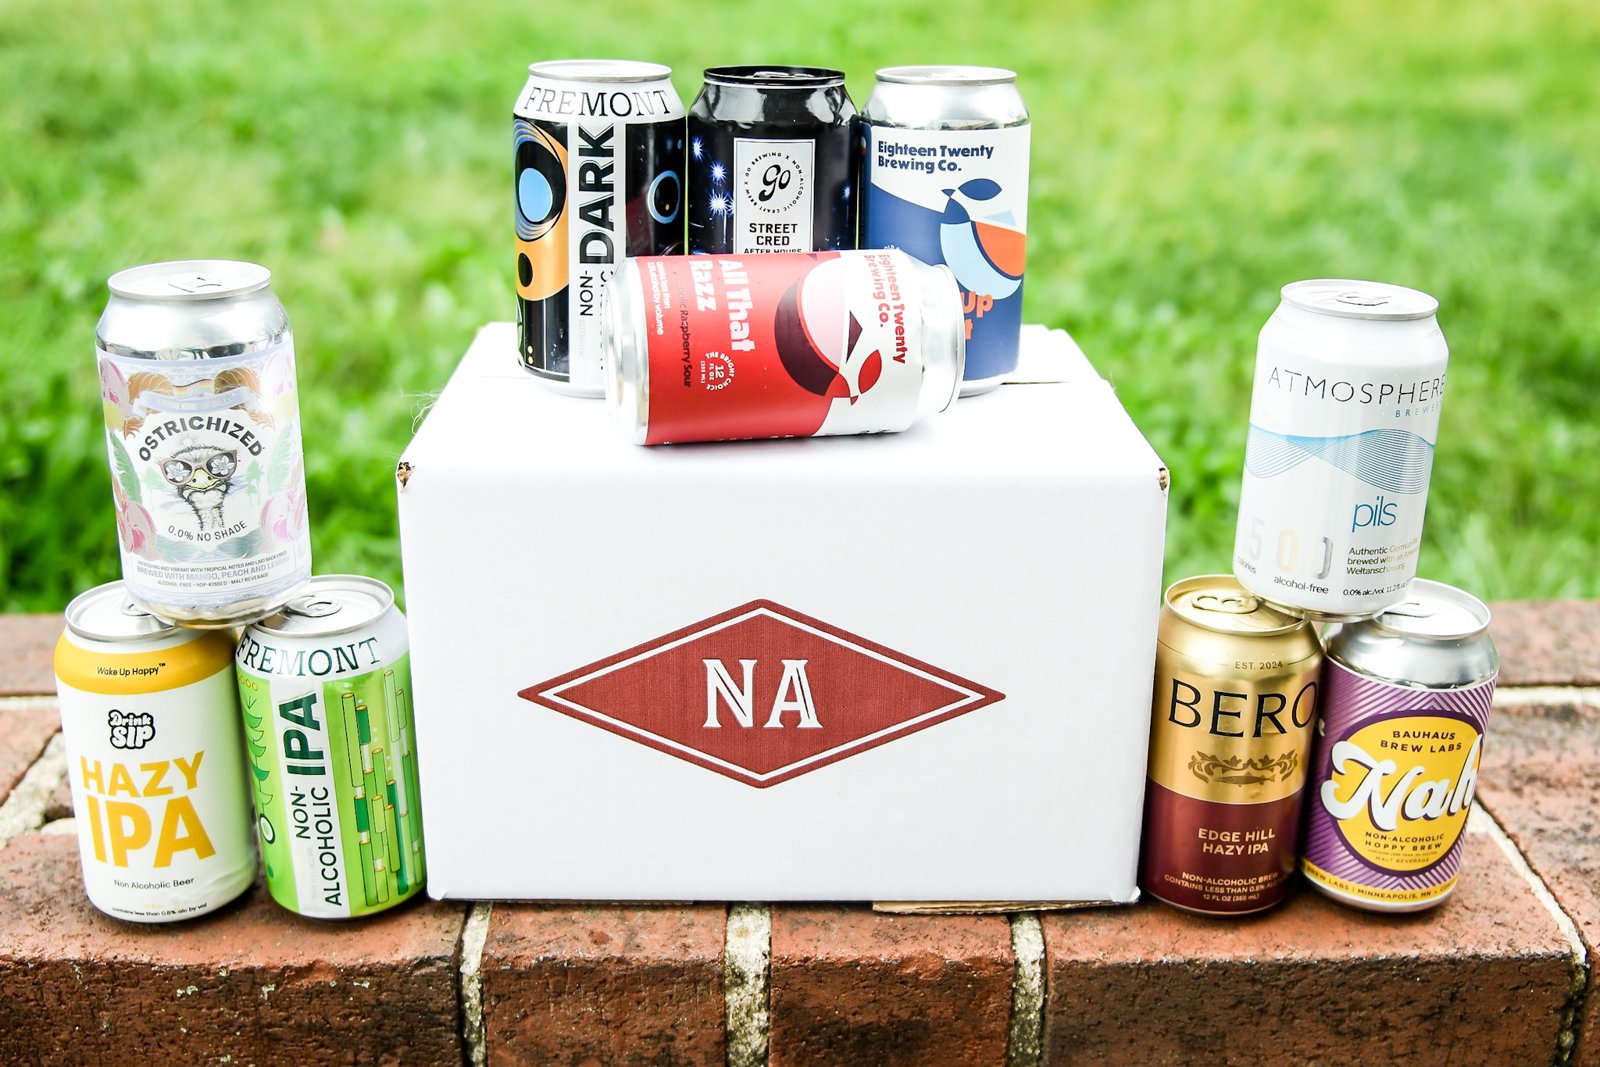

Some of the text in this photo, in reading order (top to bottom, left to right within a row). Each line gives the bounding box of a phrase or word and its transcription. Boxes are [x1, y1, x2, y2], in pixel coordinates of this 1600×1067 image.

[523, 87, 671, 117] FREMONT
[878, 141, 994, 159] Eighteen Twenty
[878, 155, 962, 174] Brewing Co.
[578, 122, 615, 265] DARK
[749, 223, 799, 234] STREET
[756, 235, 790, 246] CRED
[579, 270, 594, 316] NON-
[688, 260, 717, 312] Razz
[864, 254, 891, 328] Brewing Co.
[650, 292, 661, 304] by
[718, 260, 756, 352] All That
[878, 254, 901, 302] Eighteen
[892, 303, 908, 365] Twenty
[655, 304, 665, 336] volume
[709, 362, 715, 371] FL
[715, 364, 724, 379] 12
[720, 351, 735, 378] BRIGHT
[683, 364, 692, 388] Sour
[706, 377, 732, 391] CHOICE
[138, 415, 263, 462] OSTRICHIZED
[1352, 496, 1398, 533] pils
[168, 520, 247, 542] 0.0% NO SHADE
[1347, 557, 1379, 565] brewed
[1380, 556, 1395, 564] with
[1348, 546, 1388, 556] Authentic
[137, 565, 164, 579] BREWED
[164, 572, 185, 581] WITH
[221, 568, 249, 579] PEACH
[250, 564, 266, 574] AND
[204, 565, 228, 573] TROPICAL
[244, 572, 269, 582] BEVERAGE
[1273, 576, 1329, 594] alcohol-free
[237, 632, 381, 677] FREMONT
[97, 667, 118, 676] Wake
[119, 668, 131, 677] Up
[1235, 660, 1283, 670] EST. 2024
[702, 658, 824, 728] NA
[1168, 677, 1317, 738] BERO
[108, 709, 154, 727] Drink
[278, 692, 326, 776] IPA
[1393, 730, 1456, 740] BAUHAUS
[1380, 740, 1462, 753] BREW LABS
[80, 751, 205, 798] HAZY
[1321, 734, 1484, 832] Nah
[289, 785, 311, 840] NON-
[87, 795, 216, 868] IPA
[1198, 828, 1276, 842] EDGE HILL
[1365, 831, 1445, 843] NON-ALCOHOLIC
[310, 786, 342, 906] ALCOHOLIC
[1202, 842, 1269, 856] HAZY IPA
[1365, 840, 1442, 851] HOPPY BREW
[113, 877, 195, 890] Non Alcoholic Beer
[1164, 874, 1203, 891] CONTAINS
[1204, 885, 1225, 894] LESS
[1182, 872, 1257, 886] NON-ALCOHOLIC
[1258, 872, 1278, 884] BREW
[1328, 878, 1350, 891] LABS
[1357, 888, 1419, 900] MINNEAPOLIS,
[1420, 890, 1432, 898] MN
